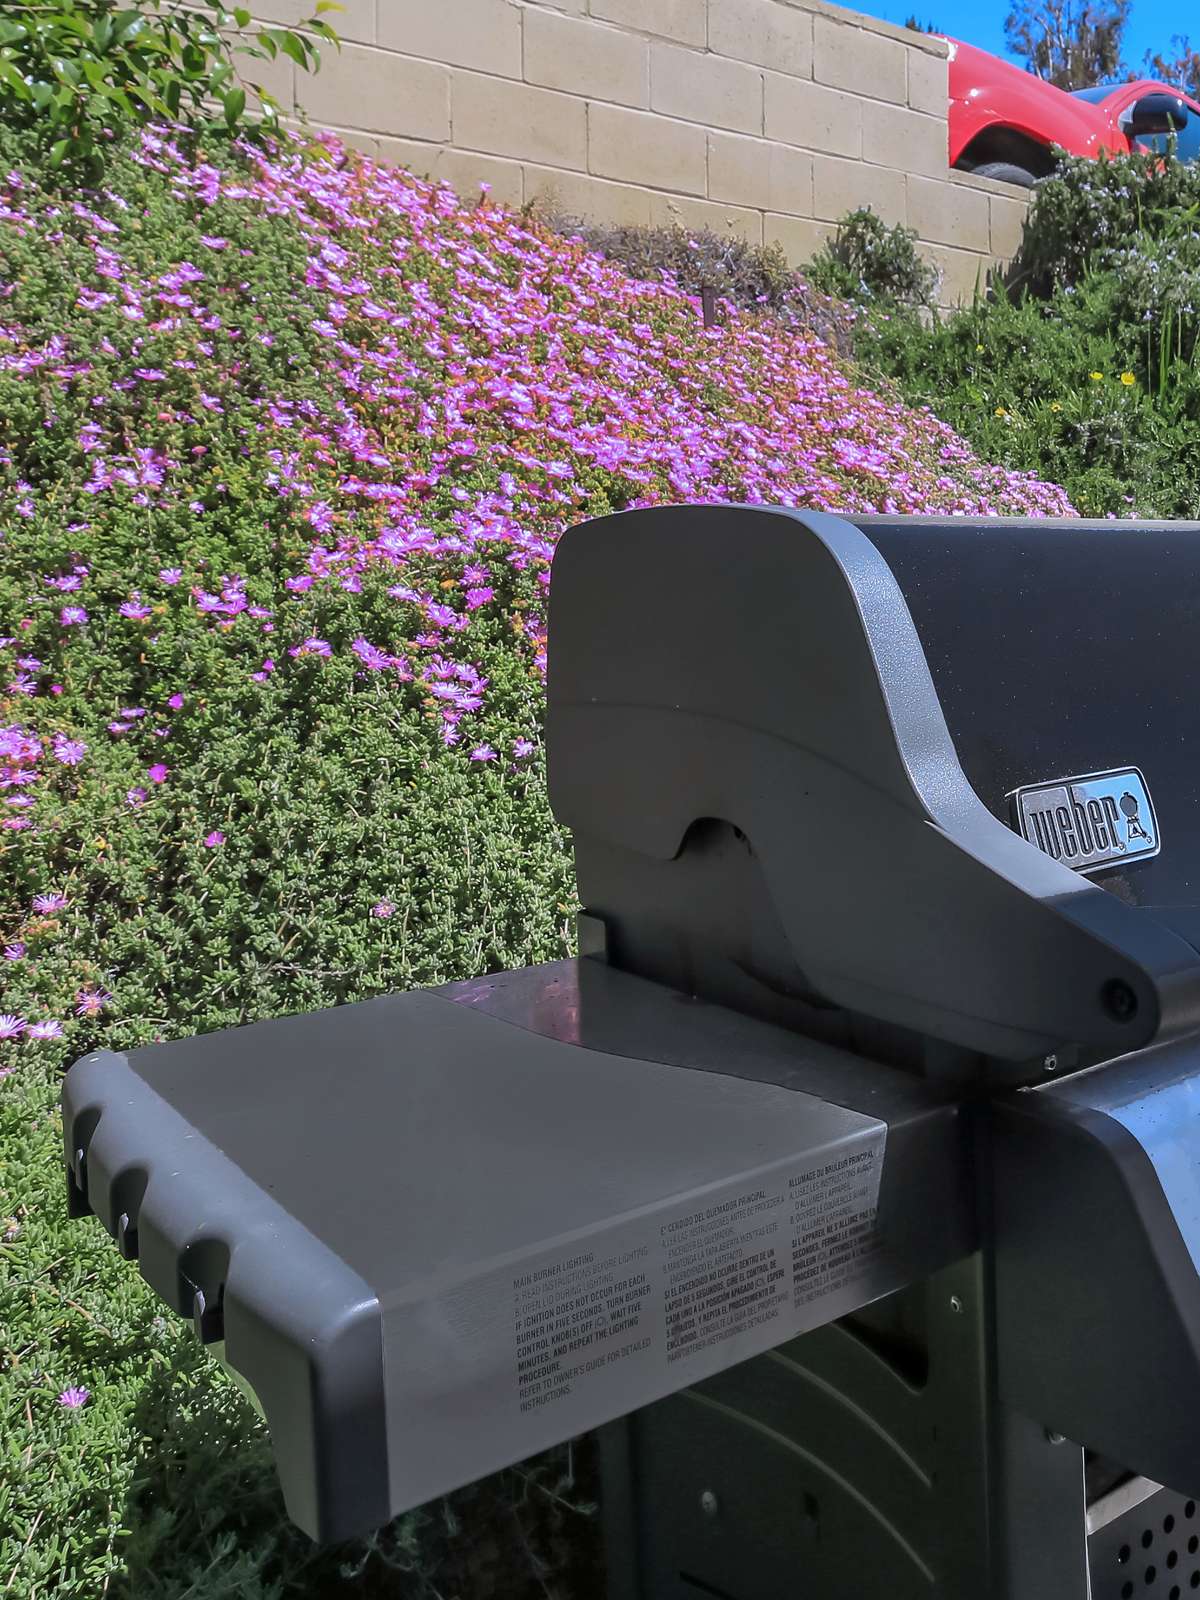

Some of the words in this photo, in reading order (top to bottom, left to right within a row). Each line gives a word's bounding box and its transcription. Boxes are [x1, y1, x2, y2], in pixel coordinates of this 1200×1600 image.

[817, 1168, 824, 1177] DU
[695, 1210, 704, 1223] DEL
[706, 1200, 737, 1219] QUEMADOR
[513, 1275, 532, 1289] MAIN
[533, 1265, 561, 1282] BURNER
[563, 1253, 594, 1271] LIGHTING
[671, 1286, 678, 1296] EL
[709, 1271, 716, 1281] NO
[739, 1256, 758, 1270] DENTRO
[760, 1253, 767, 1262] DE
[768, 1250, 774, 1259] UN
[684, 1294, 691, 1305] DE
[739, 1273, 745, 1283] EL
[746, 1264, 769, 1280] CONTROL
[770, 1261, 777, 1271] DE
[769, 1285, 776, 1295] DE
[515, 1319, 522, 1330] IF
[524, 1308, 554, 1327] IGNITION
[556, 1300, 574, 1315] DOES
[575, 1295, 590, 1308] NOT
[591, 1286, 613, 1302] OCCUR
[615, 1281, 627, 1293] FOR
[629, 1274, 645, 1288] EACH
[516, 1326, 544, 1344] BURNER
[546, 1322, 553, 1332] IN
[555, 1316, 571, 1329] FIVE
[606, 1296, 624, 1310] TURN
[625, 1286, 651, 1303] BURNER
[693, 1304, 698, 1314] A
[698, 1301, 705, 1312] LA
[731, 1282, 754, 1299] APAGADO
[517, 1338, 549, 1358] CONTROL
[581, 1321, 593, 1333] OFF
[610, 1309, 626, 1322] WAIT
[628, 1303, 641, 1315] FIVE
[553, 1344, 567, 1358] AND
[569, 1334, 594, 1352] REPEAT
[595, 1328, 608, 1342] THE
[609, 1317, 638, 1336] LIGHTING
[519, 1382, 541, 1398] REFER
[543, 1378, 552, 1389] TO
[586, 1357, 606, 1372] GUIDE
[607, 1351, 620, 1364] FOR
[622, 1339, 651, 1358] DETAILED
